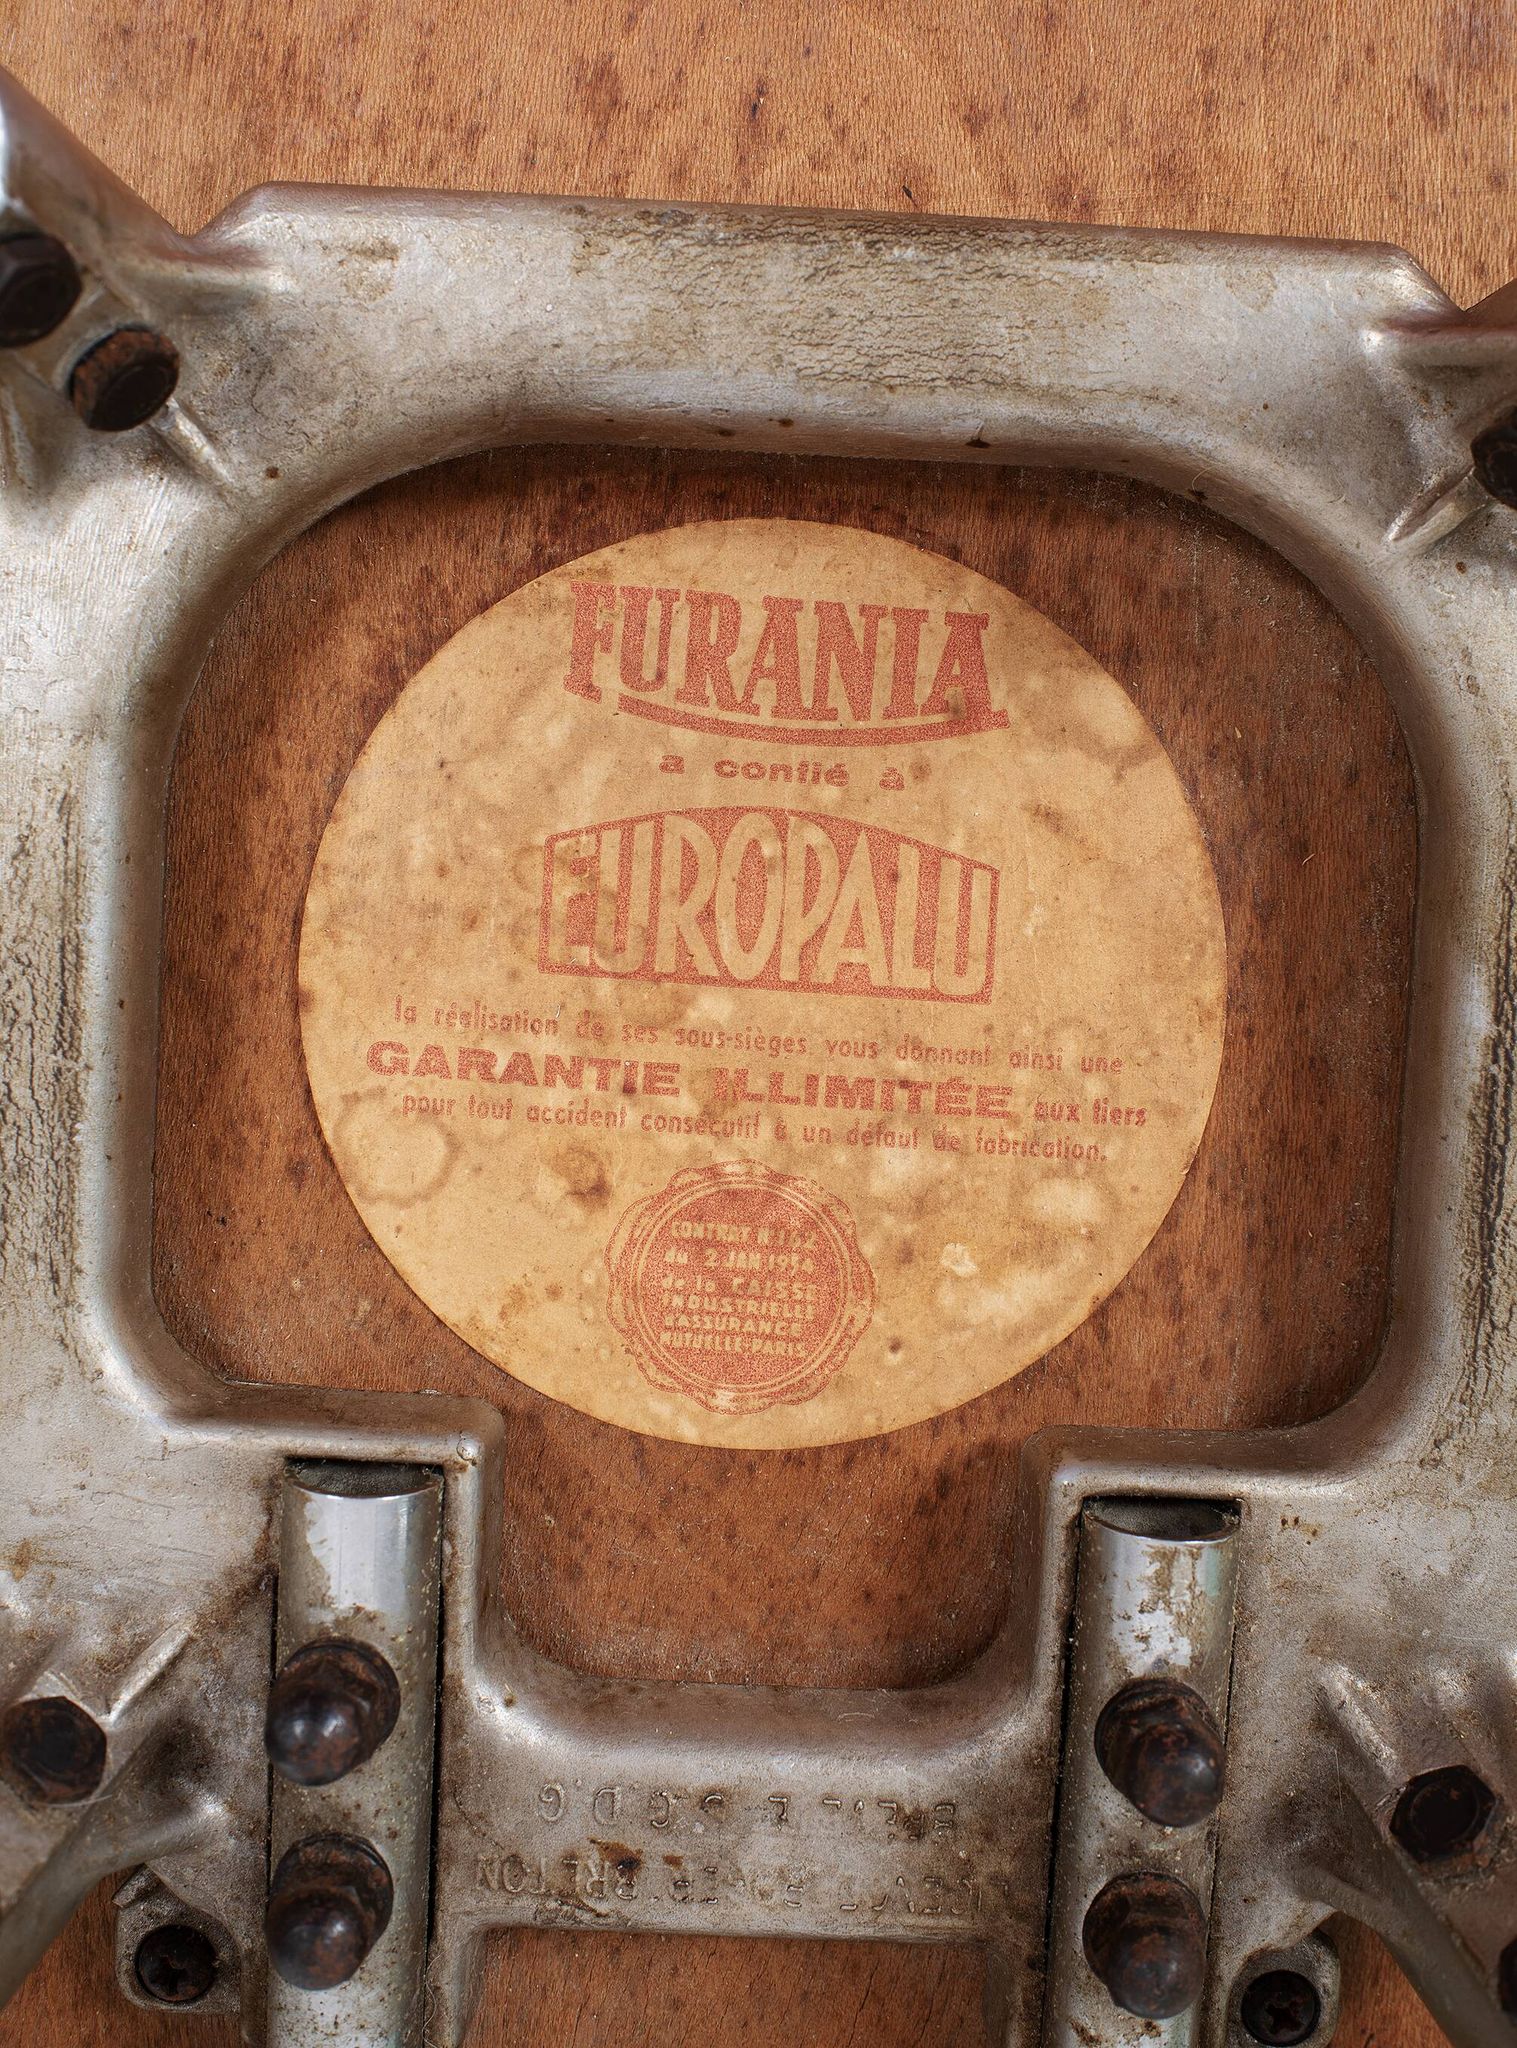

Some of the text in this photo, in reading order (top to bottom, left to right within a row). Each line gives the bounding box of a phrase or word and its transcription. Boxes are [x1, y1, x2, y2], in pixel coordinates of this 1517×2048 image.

[563, 581, 1010, 731] FURANIA
[659, 755, 685, 775] a
[714, 758, 849, 788] confié
[547, 812, 993, 997] EUROPALU
[394, 995, 1126, 1075] la réalisation de ses sous-sièges vous donnant ainsi une
[366, 1040, 1148, 1127] GARANTIE ILLIMITÉE aux tiers
[401, 1094, 456, 1118] pour
[467, 1093, 513, 1121] tout
[525, 1097, 628, 1129] accident
[640, 1111, 761, 1140] consécutif
[801, 1124, 832, 1145] un
[846, 1117, 919, 1150] défaut
[931, 1124, 961, 1152] de
[975, 1126, 1108, 1163] fabrication.
[670, 1220, 751, 1243] CONTRAT
[664, 1247, 689, 1265] du
[704, 1249, 720, 1269] 2
[660, 1275, 817, 1301] de la CAISSE
[660, 1293, 817, 1320] INDUSTRIELLE
